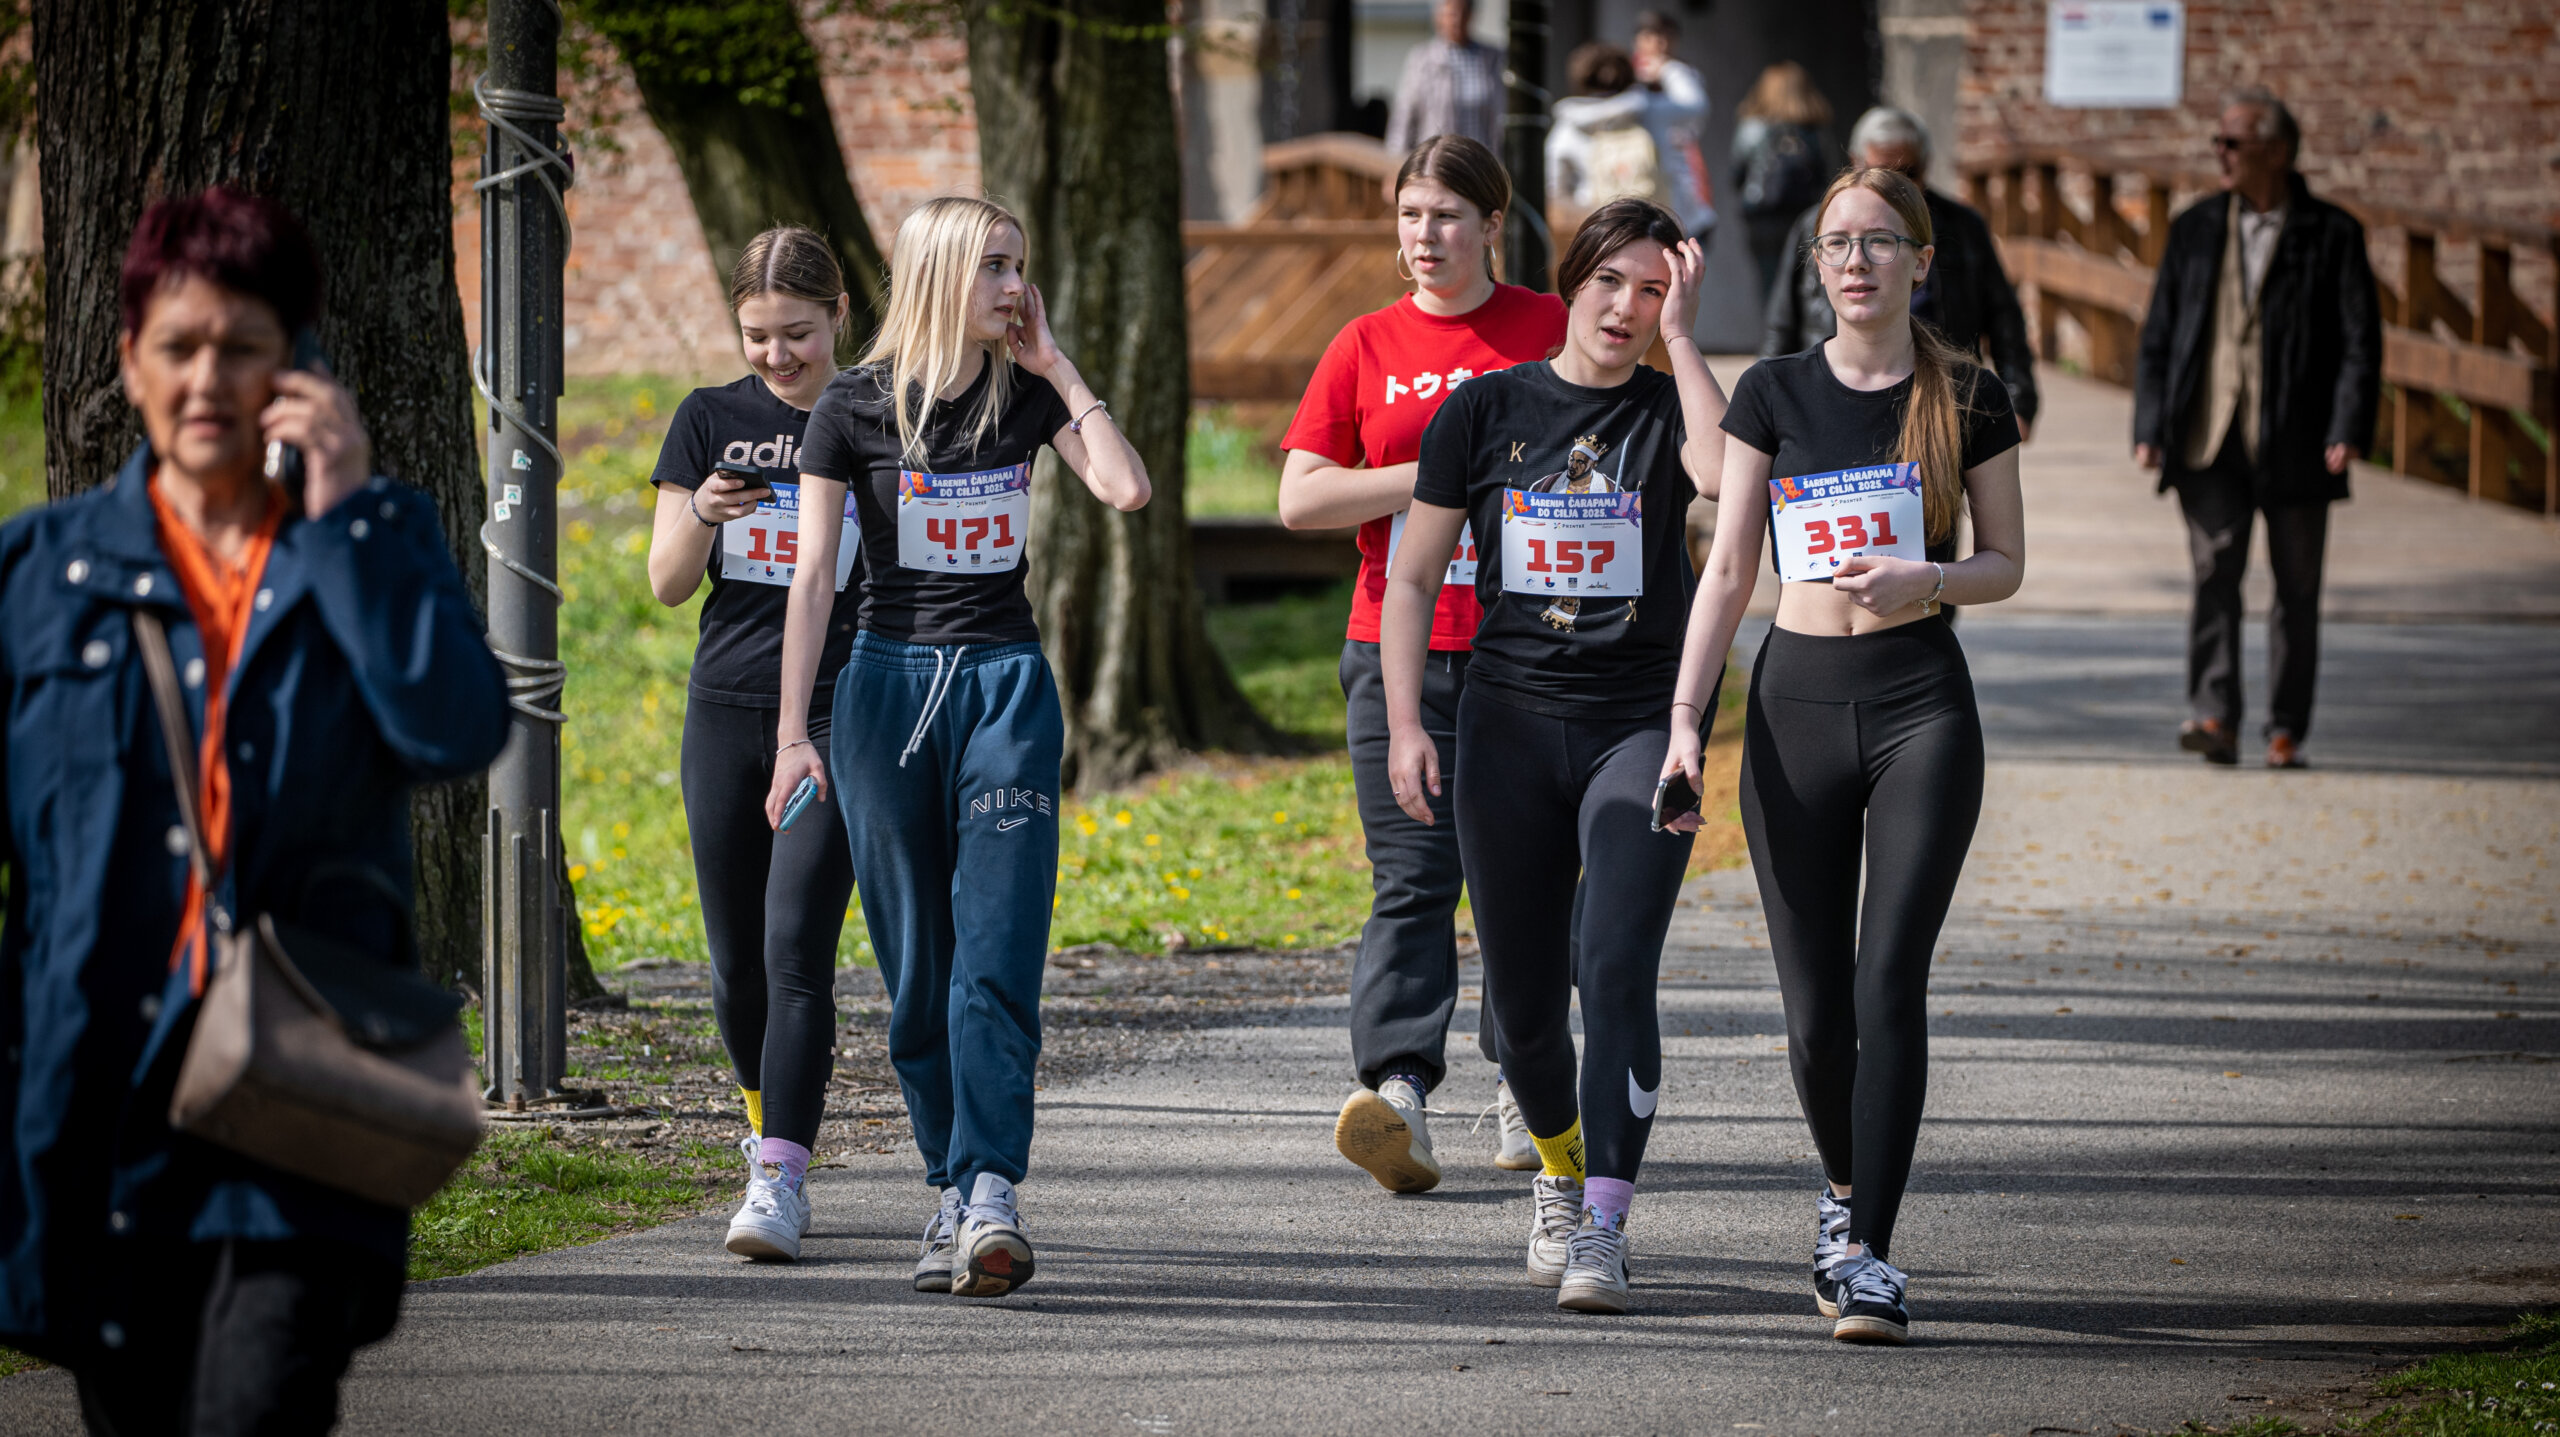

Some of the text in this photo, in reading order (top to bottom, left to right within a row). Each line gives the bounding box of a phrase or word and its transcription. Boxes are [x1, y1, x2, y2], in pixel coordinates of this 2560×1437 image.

[1509, 442, 1526, 462] K
[931, 470, 1014, 488] ŠARENIM ČARAPAMA
[1803, 468, 1893, 489] ŠARENIM ČARAPAMA
[940, 482, 1006, 497] DO CILJA 2025.
[1812, 488, 1826, 498] DO
[1828, 485, 1855, 496] CILJA
[1858, 480, 1884, 491] 2025.
[780, 499, 799, 509] CILJ
[1530, 495, 1617, 508] ŠARENIM ČARAPAMA
[1537, 508, 1607, 518] DO CILJA 2025.
[927, 513, 1015, 550] 471
[1804, 512, 1897, 555] 331
[747, 528, 798, 564] 15
[1527, 539, 1615, 574] 157
[970, 787, 1051, 819] NIKE
